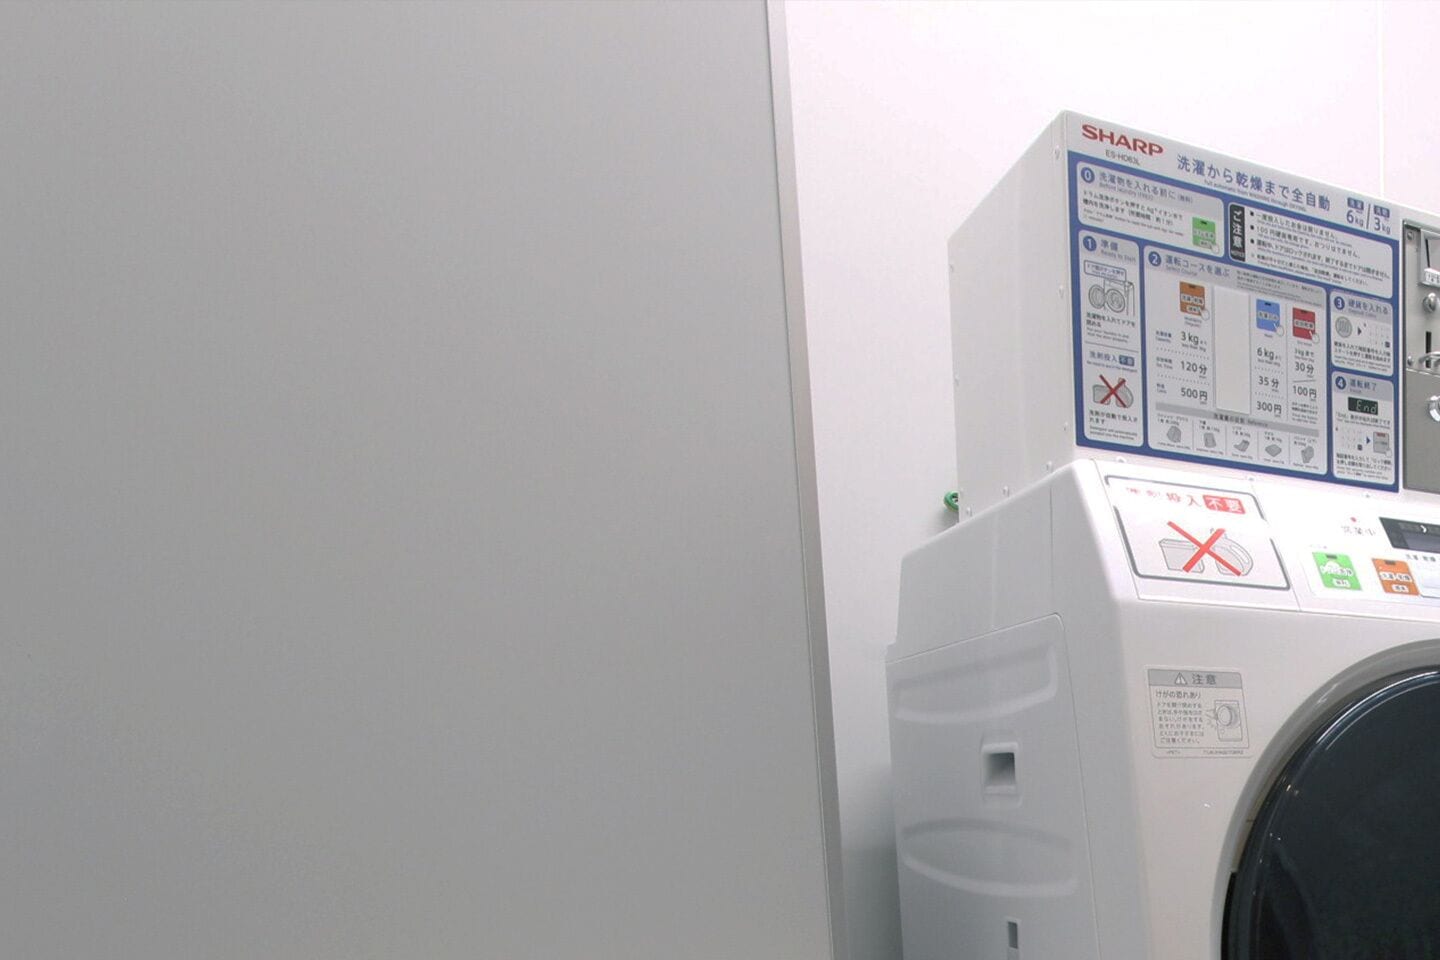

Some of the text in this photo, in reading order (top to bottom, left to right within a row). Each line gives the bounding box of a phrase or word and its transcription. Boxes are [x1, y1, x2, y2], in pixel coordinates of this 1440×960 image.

[1082, 123, 1164, 156] SHARP
[1177, 154, 1330, 212] 洗濯から乾燥まで全自動
[1232, 210, 1243, 248] ご注意
[1165, 254, 1230, 278] 運転コースを選ぶ
[1181, 361, 1207, 375] 120分
[1295, 362, 1314, 375] 30分
[1293, 385, 1317, 399] 100円
[1350, 379, 1377, 391] 運転終了
[1181, 387, 1208, 401] 500円
[1256, 401, 1282, 415] 300円
[1356, 400, 1377, 414] End
[1206, 496, 1244, 513] 不要
[1192, 674, 1216, 685] 注意
